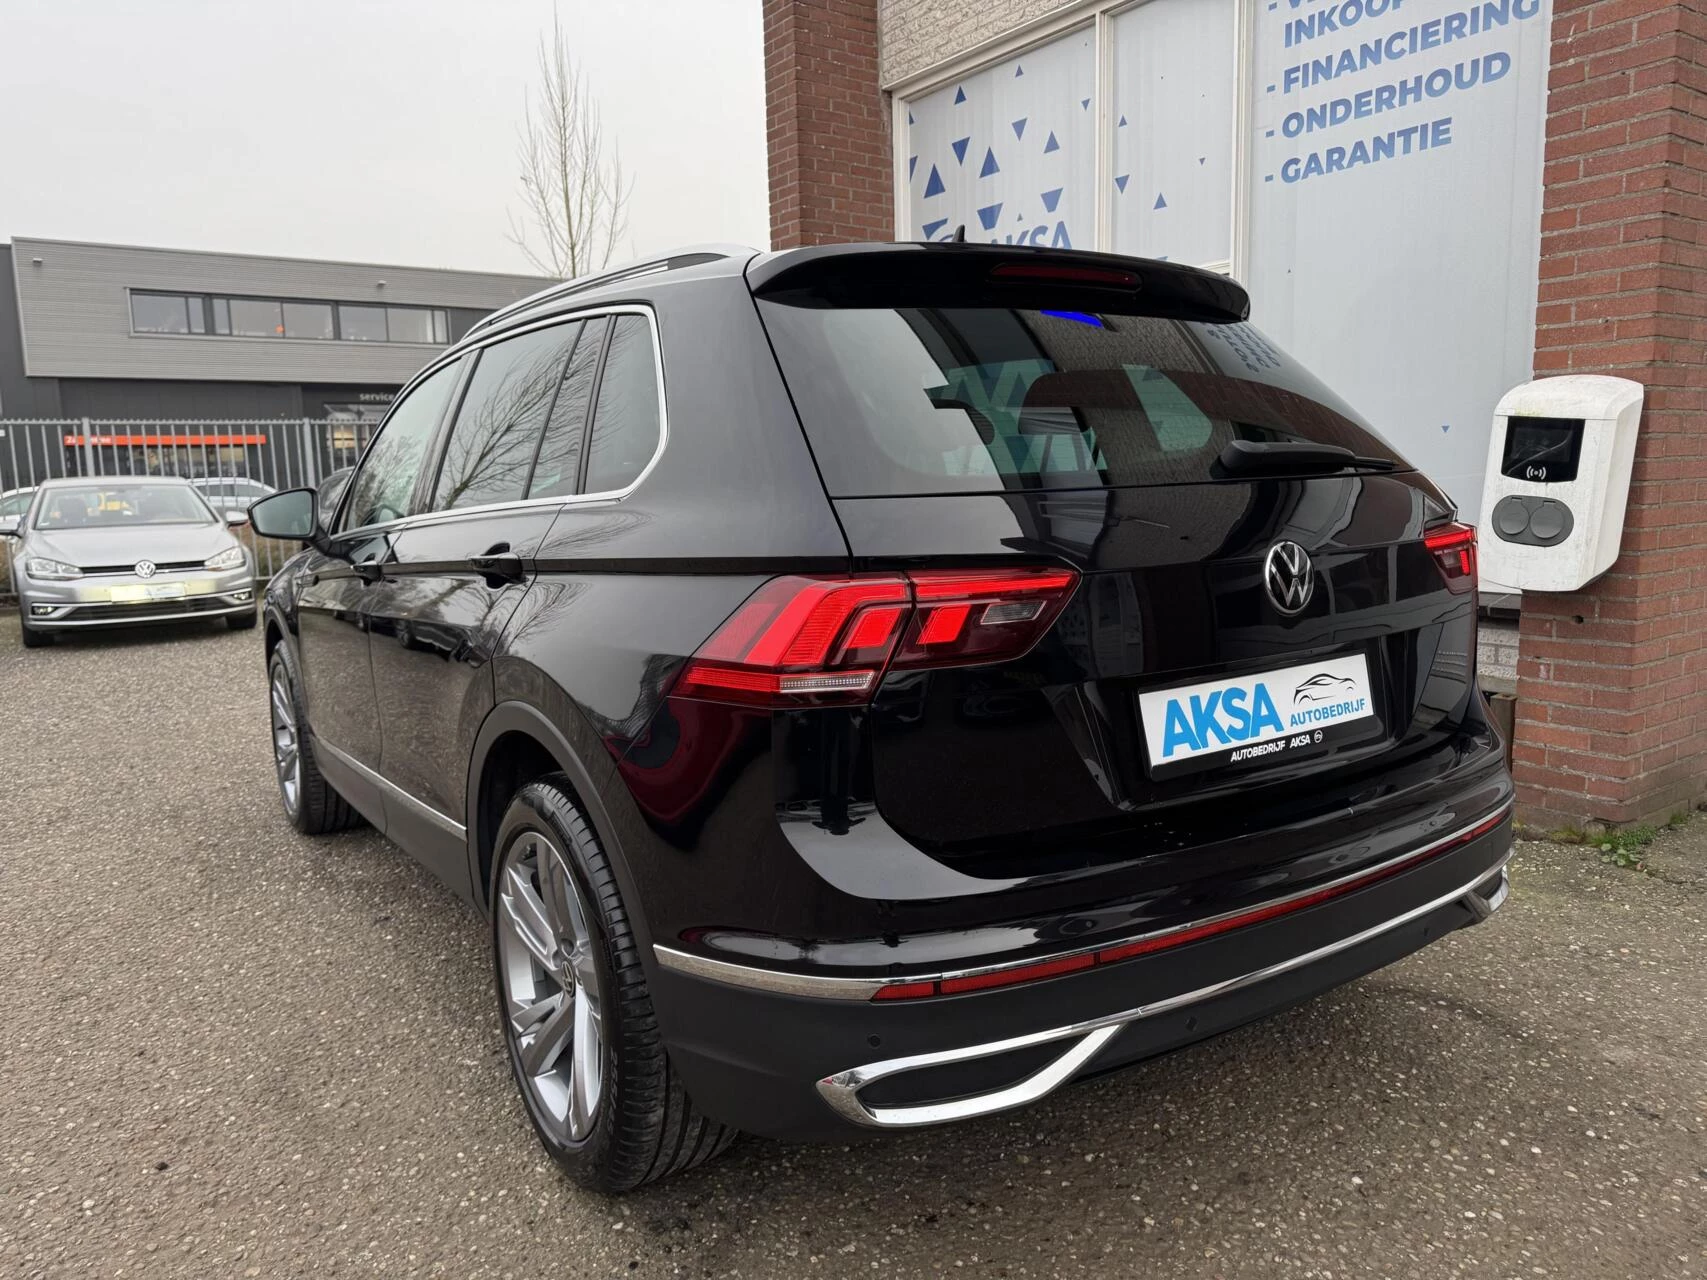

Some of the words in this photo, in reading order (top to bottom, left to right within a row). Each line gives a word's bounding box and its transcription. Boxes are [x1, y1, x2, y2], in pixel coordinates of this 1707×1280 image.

[1284, 0, 1540, 94] FINANCIERING
[1282, 52, 1511, 138] ONDERHOUD
[1281, 117, 1452, 184] GARANTIE
[1162, 682, 1285, 758] AKSA
[1290, 698, 1366, 727] AUTOBEDRIJF
[1230, 740, 1286, 763] AUTOBEDRIJF
[1289, 734, 1311, 749] AKSA
